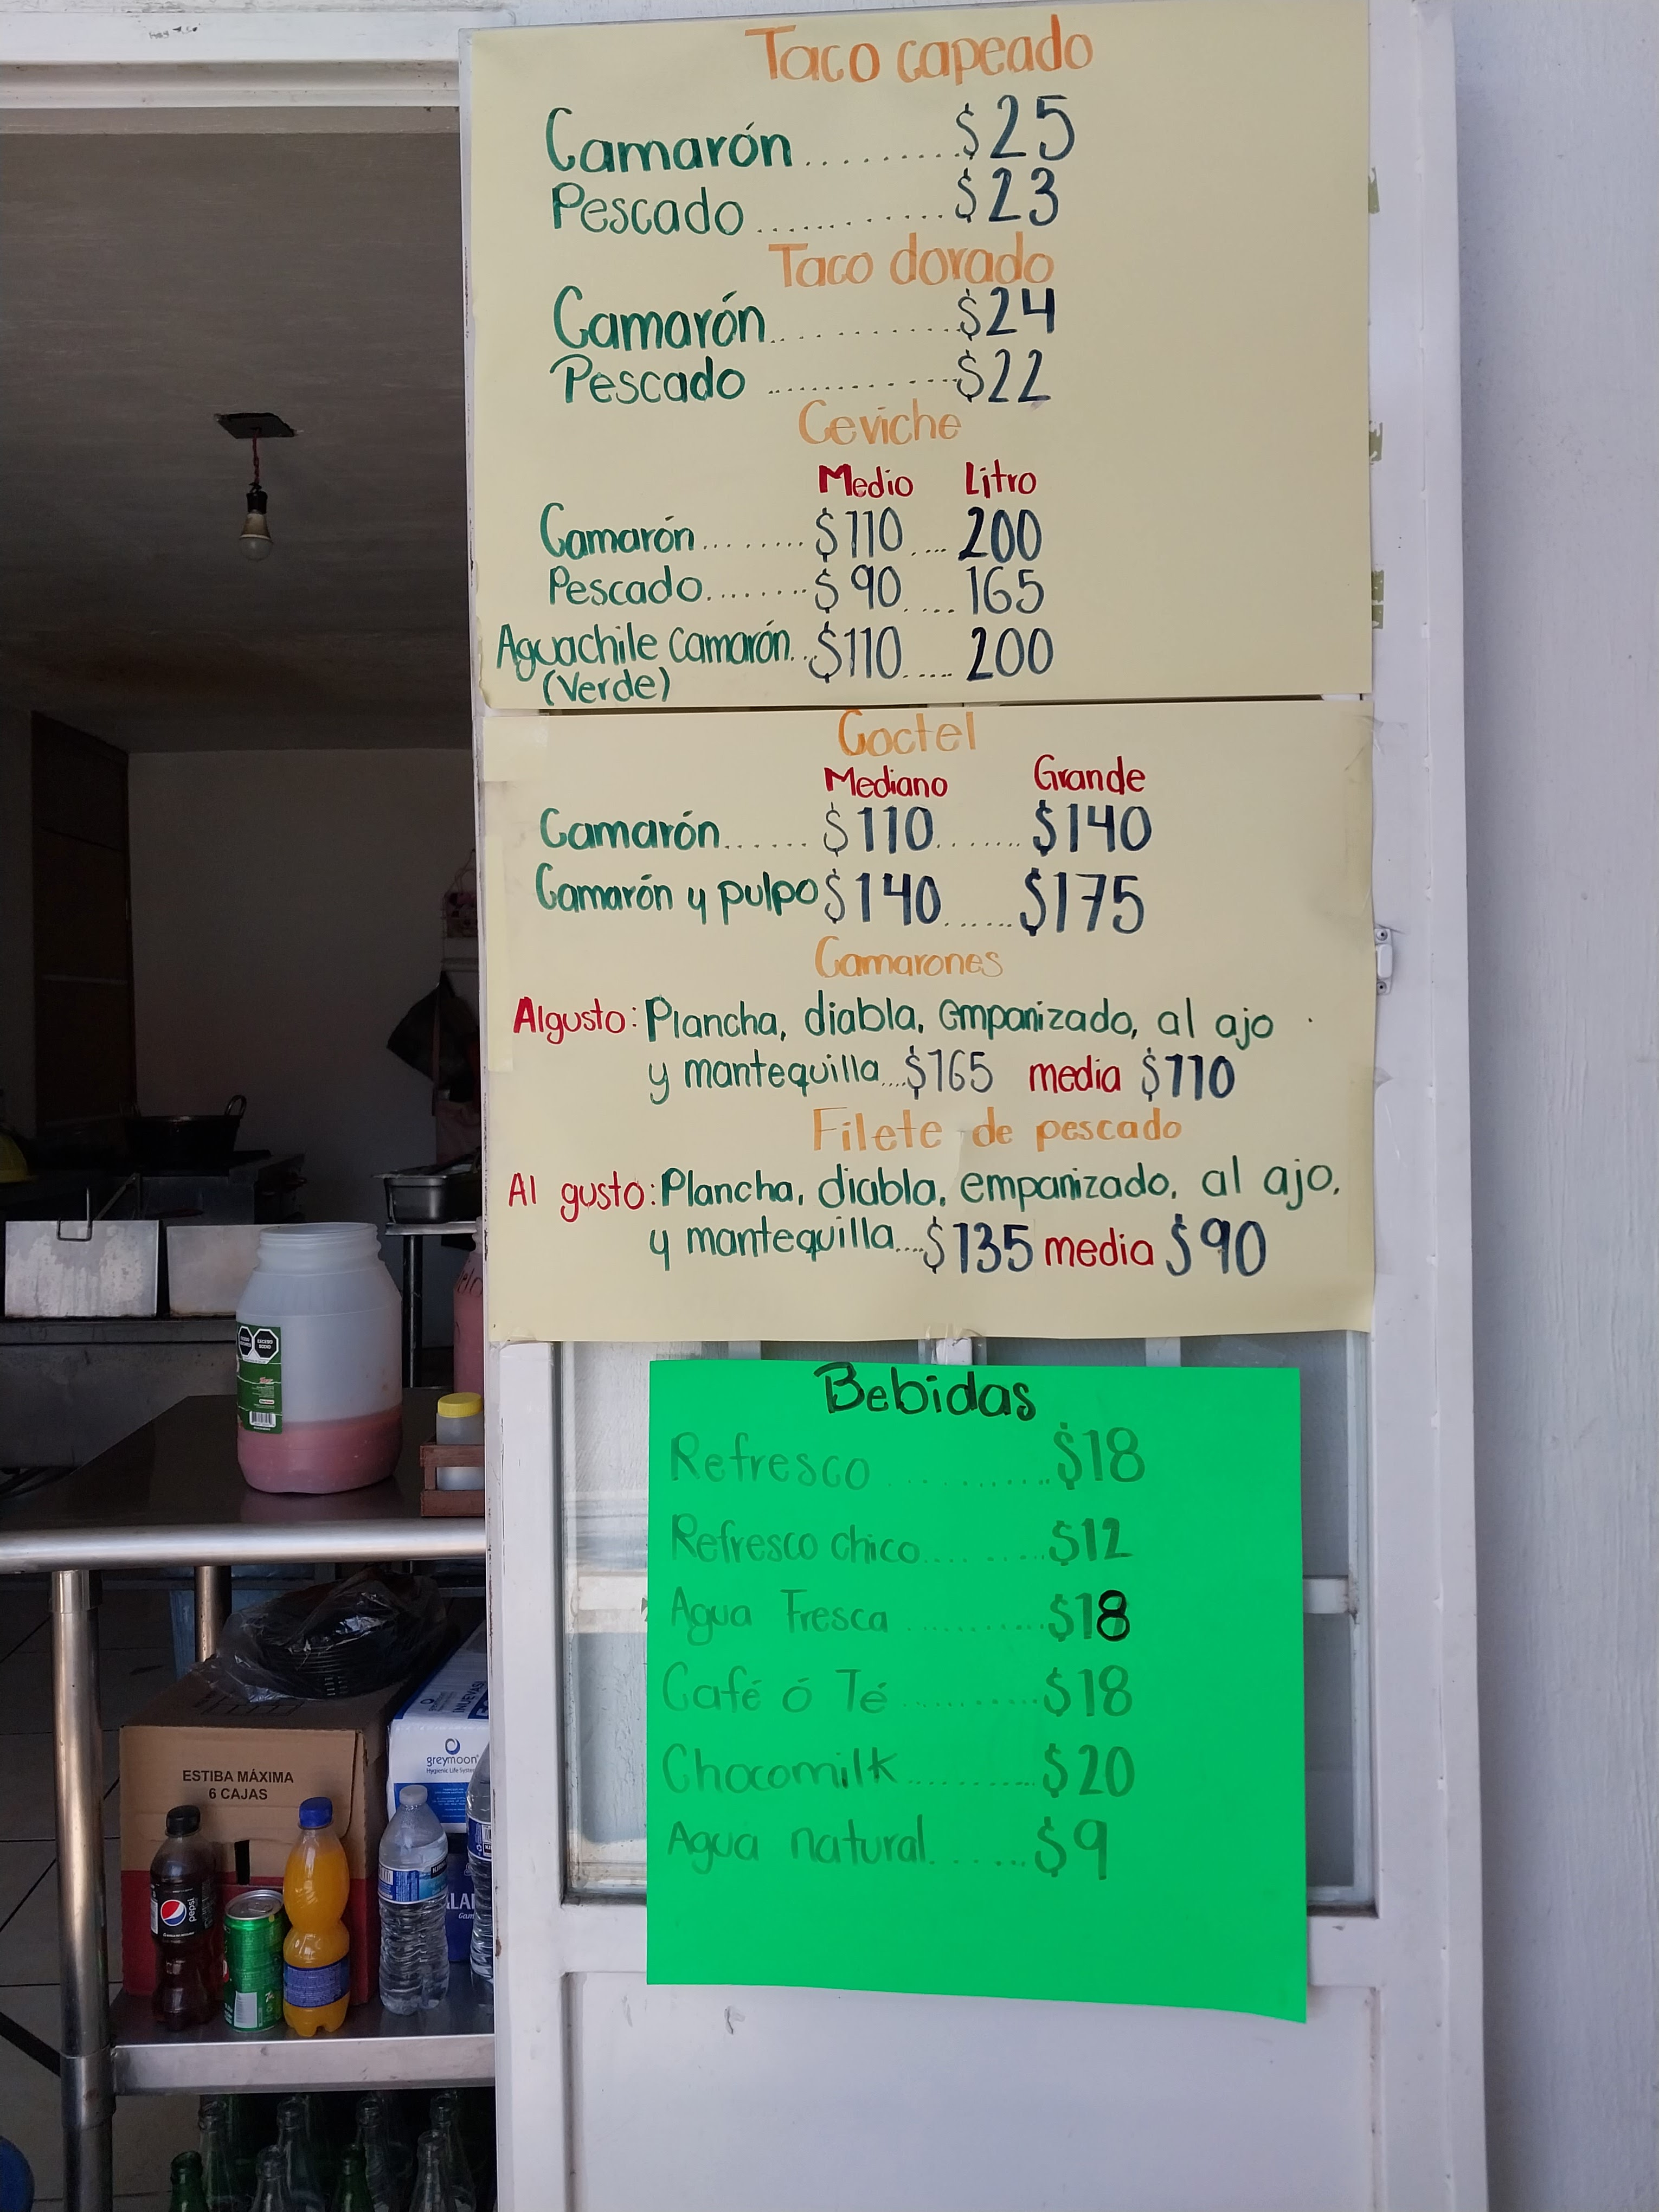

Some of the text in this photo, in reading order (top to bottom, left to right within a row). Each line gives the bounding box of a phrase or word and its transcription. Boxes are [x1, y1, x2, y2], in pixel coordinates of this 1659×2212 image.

[744, 13, 1094, 86] Taco capeado
[545, 94, 1075, 173] Camarón $25
[551, 167, 1059, 236] Pescado $23
[768, 232, 1054, 287] Taco dorado
[554, 285, 1056, 351] Camarón $24
[549, 348, 1052, 406] Pescado $22
[799, 398, 961, 445] Ceviche
[818, 459, 1037, 499] Medio Litro
[540, 502, 1042, 564] Camarón $110 200
[549, 565, 703, 606] Pescado
[966, 565, 1044, 615] 165
[496, 622, 658, 682] Aguachile
[808, 620, 902, 684] $110
[966, 626, 1054, 682] 200
[543, 666, 671, 706] (Verde)
[838, 709, 976, 757] Coctel
[824, 754, 1146, 799] Mediano Grande
[539, 799, 1152, 858] Camarón $110 $140
[536, 862, 1144, 937] Camarón y pulpo $140 $175
[815, 936, 1002, 978] Camarones
[645, 995, 786, 1043] Plancha,
[805, 989, 924, 1037] diabla,
[938, 997, 1138, 1040] empanizado,
[1157, 996, 1195, 1039] al
[1215, 1007, 1275, 1051] ajo
[648, 1045, 1236, 1105] y mantequilla $165 media $110
[813, 1107, 1181, 1152] Filete de pescado
[509, 1172, 537, 1207] Al
[661, 1167, 803, 1207] Plancha,
[818, 1163, 946, 1208] diabla,
[960, 1162, 1177, 1212] empanizado,
[1201, 1155, 1241, 1197] al
[1263, 1159, 1340, 1212] ajo,
[650, 1213, 1266, 1277] y mantequilla $135 media $90
[813, 1361, 1037, 1422] Bebidas
[670, 1422, 1146, 1490] Refresco $18
[672, 1513, 818, 1563] Refresco
[1049, 1517, 1134, 1566] $12
[671, 1586, 1131, 1646] Agua Fresca $18
[663, 1661, 1133, 1717] Café ó Té $18
[183, 1768, 294, 1783] ESTIBA MÁXIMA
[427, 1756, 477, 1767] greymoon
[663, 1742, 1135, 1799] Chocomilk $20
[209, 1788, 268, 1800] 6 CAJAS
[667, 1814, 1108, 1881] Agua natural $9
[187, 1897, 197, 1922] pepsi
